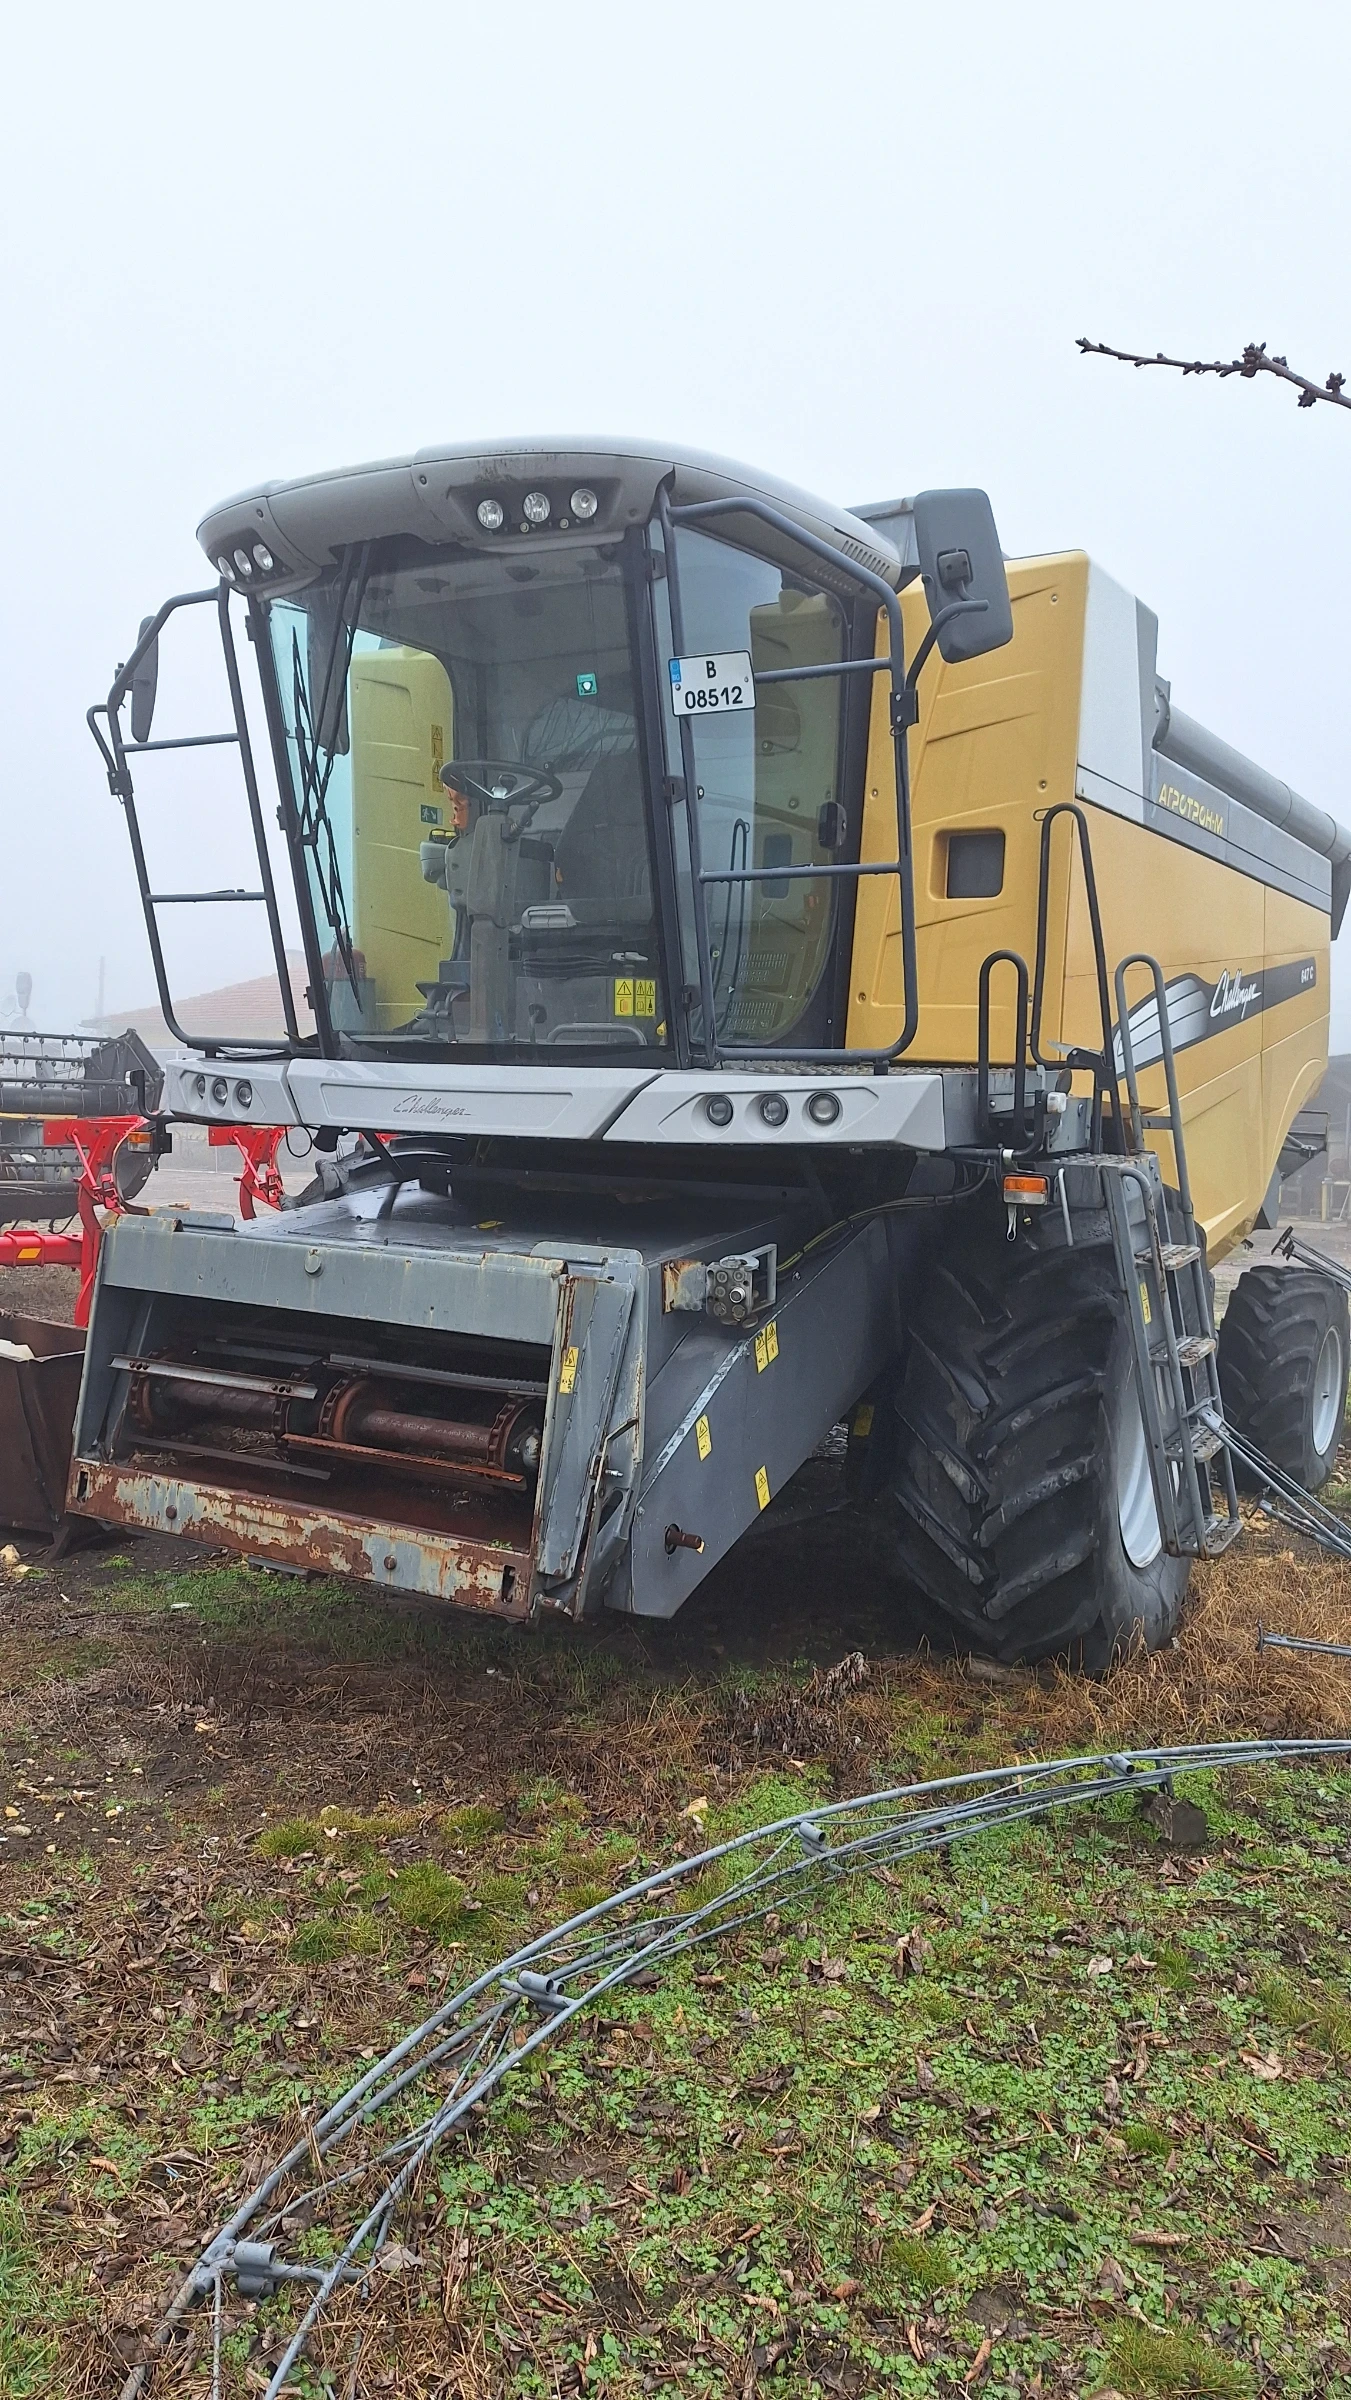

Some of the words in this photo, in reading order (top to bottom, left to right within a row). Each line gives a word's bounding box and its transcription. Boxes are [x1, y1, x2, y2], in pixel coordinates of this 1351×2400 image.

[706, 660, 717, 679] B
[684, 685, 743, 709] 08512
[1209, 967, 1262, 1020] Challenger
[393, 1094, 472, 1121] Challenger
